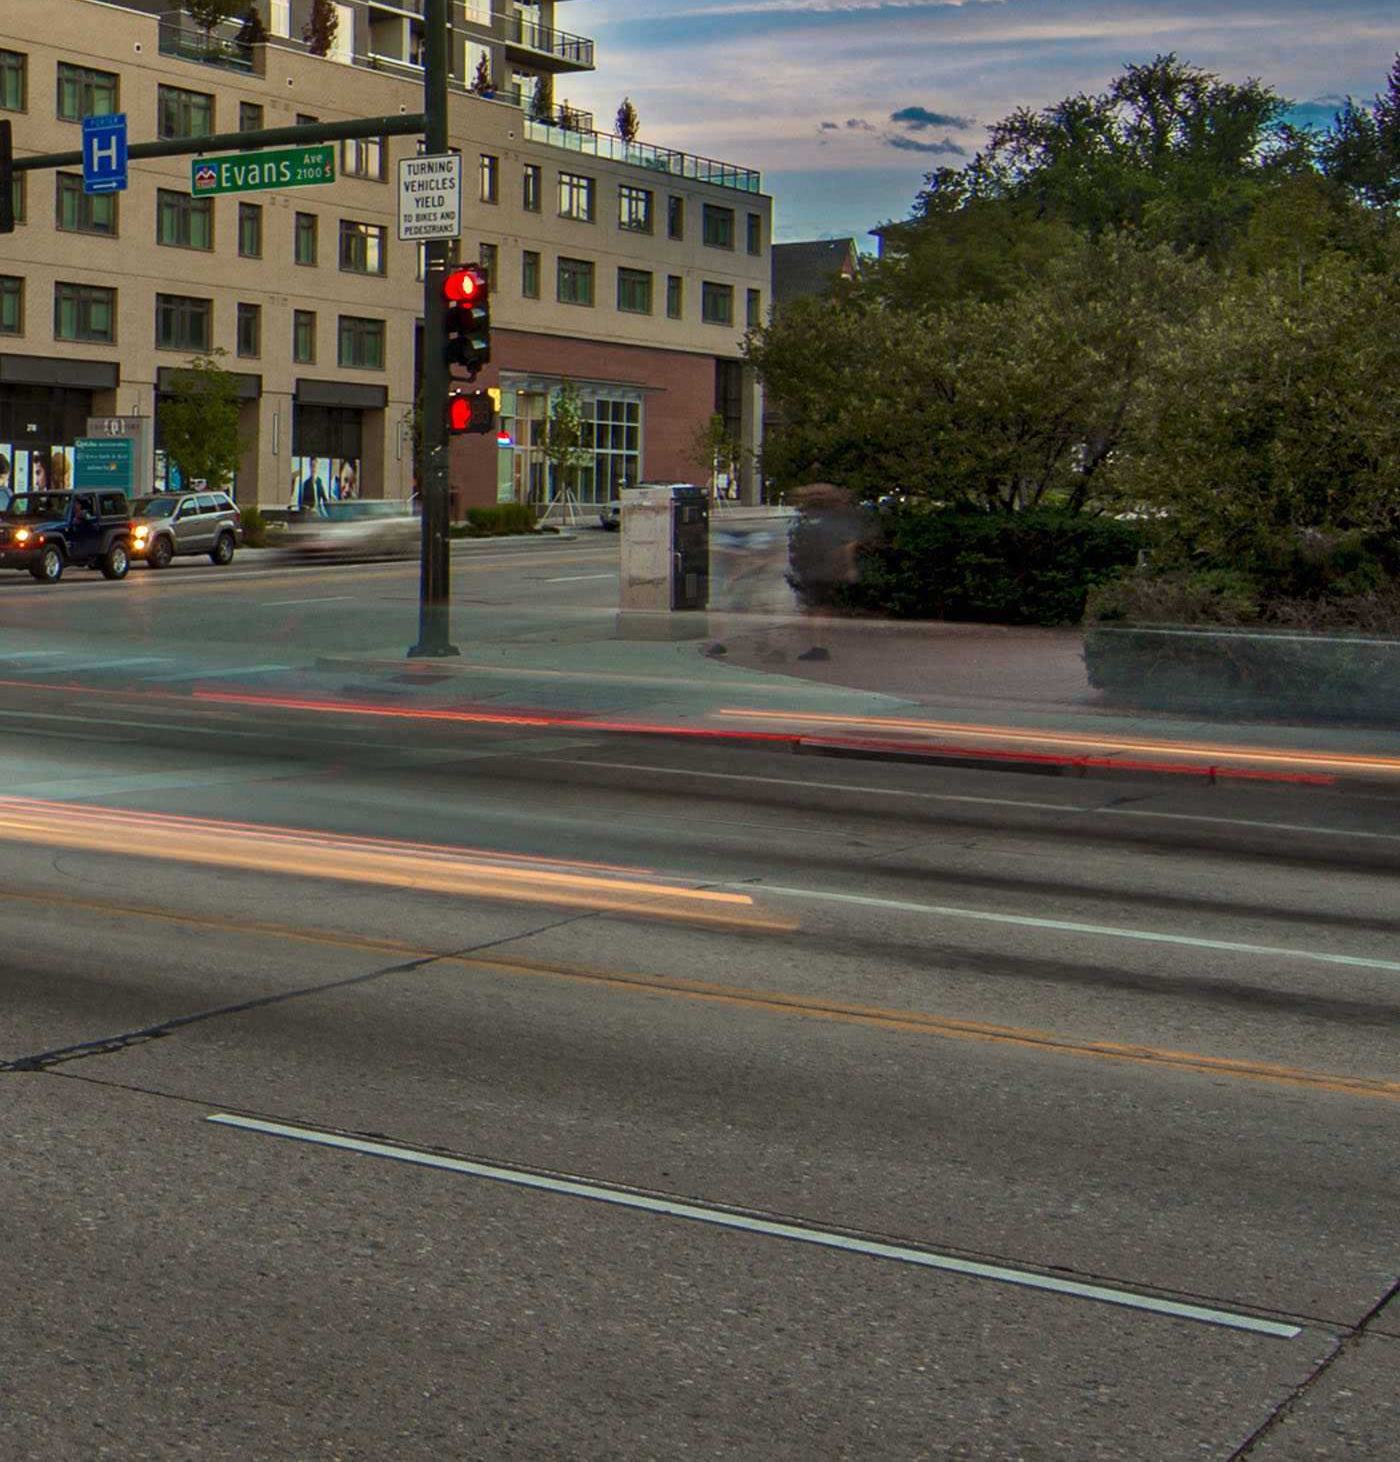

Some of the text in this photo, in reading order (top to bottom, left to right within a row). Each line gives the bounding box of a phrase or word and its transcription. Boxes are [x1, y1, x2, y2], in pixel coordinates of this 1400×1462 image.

[92, 135, 117, 172] H
[221, 161, 292, 187] Evans
[303, 153, 323, 165] Ave
[296, 167, 322, 180] 2100
[407, 161, 453, 175] TURNING
[404, 178, 456, 192] VEHICLES
[415, 196, 445, 208] YIELD
[404, 211, 456, 223] TO BIKES AND
[405, 224, 453, 235] PEDESTRIANS
